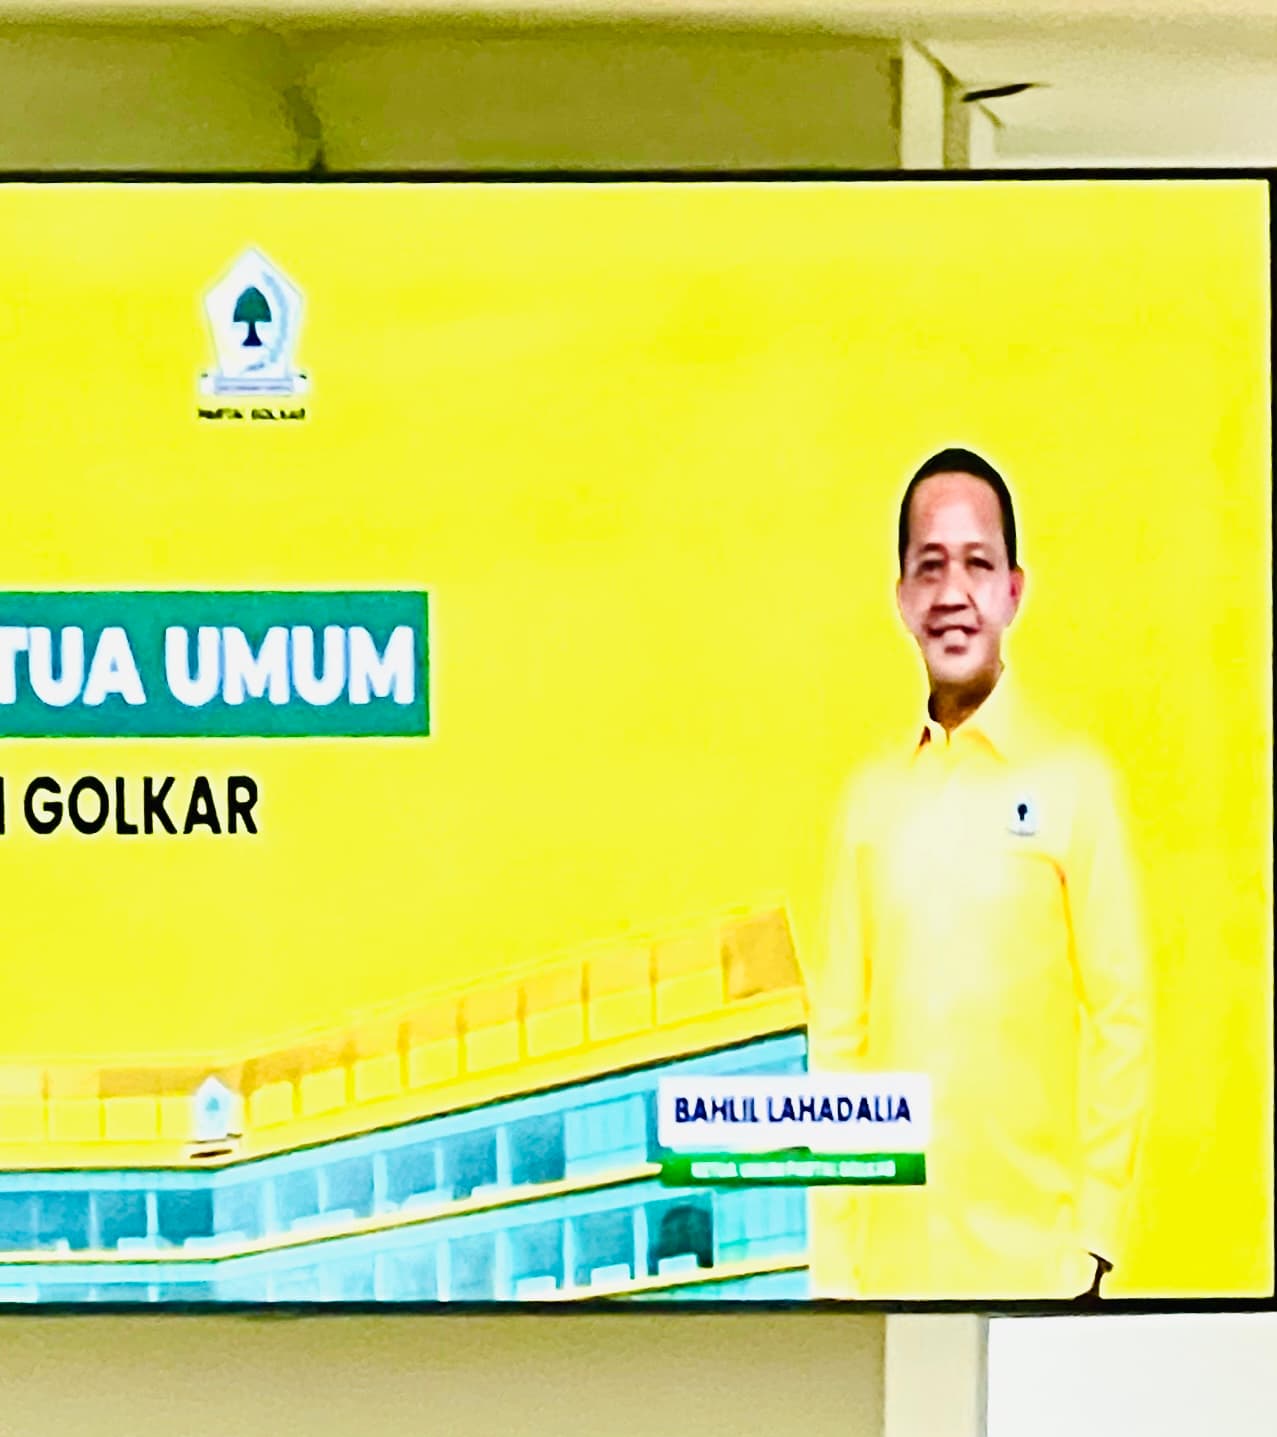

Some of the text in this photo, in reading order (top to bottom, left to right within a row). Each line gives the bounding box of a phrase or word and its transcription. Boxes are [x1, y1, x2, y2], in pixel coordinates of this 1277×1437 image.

[165, 625, 415, 707] UMUM
[23, 775, 258, 835] GOLKAR
[674, 1095, 912, 1123] BAHLIL LAHADALIA
